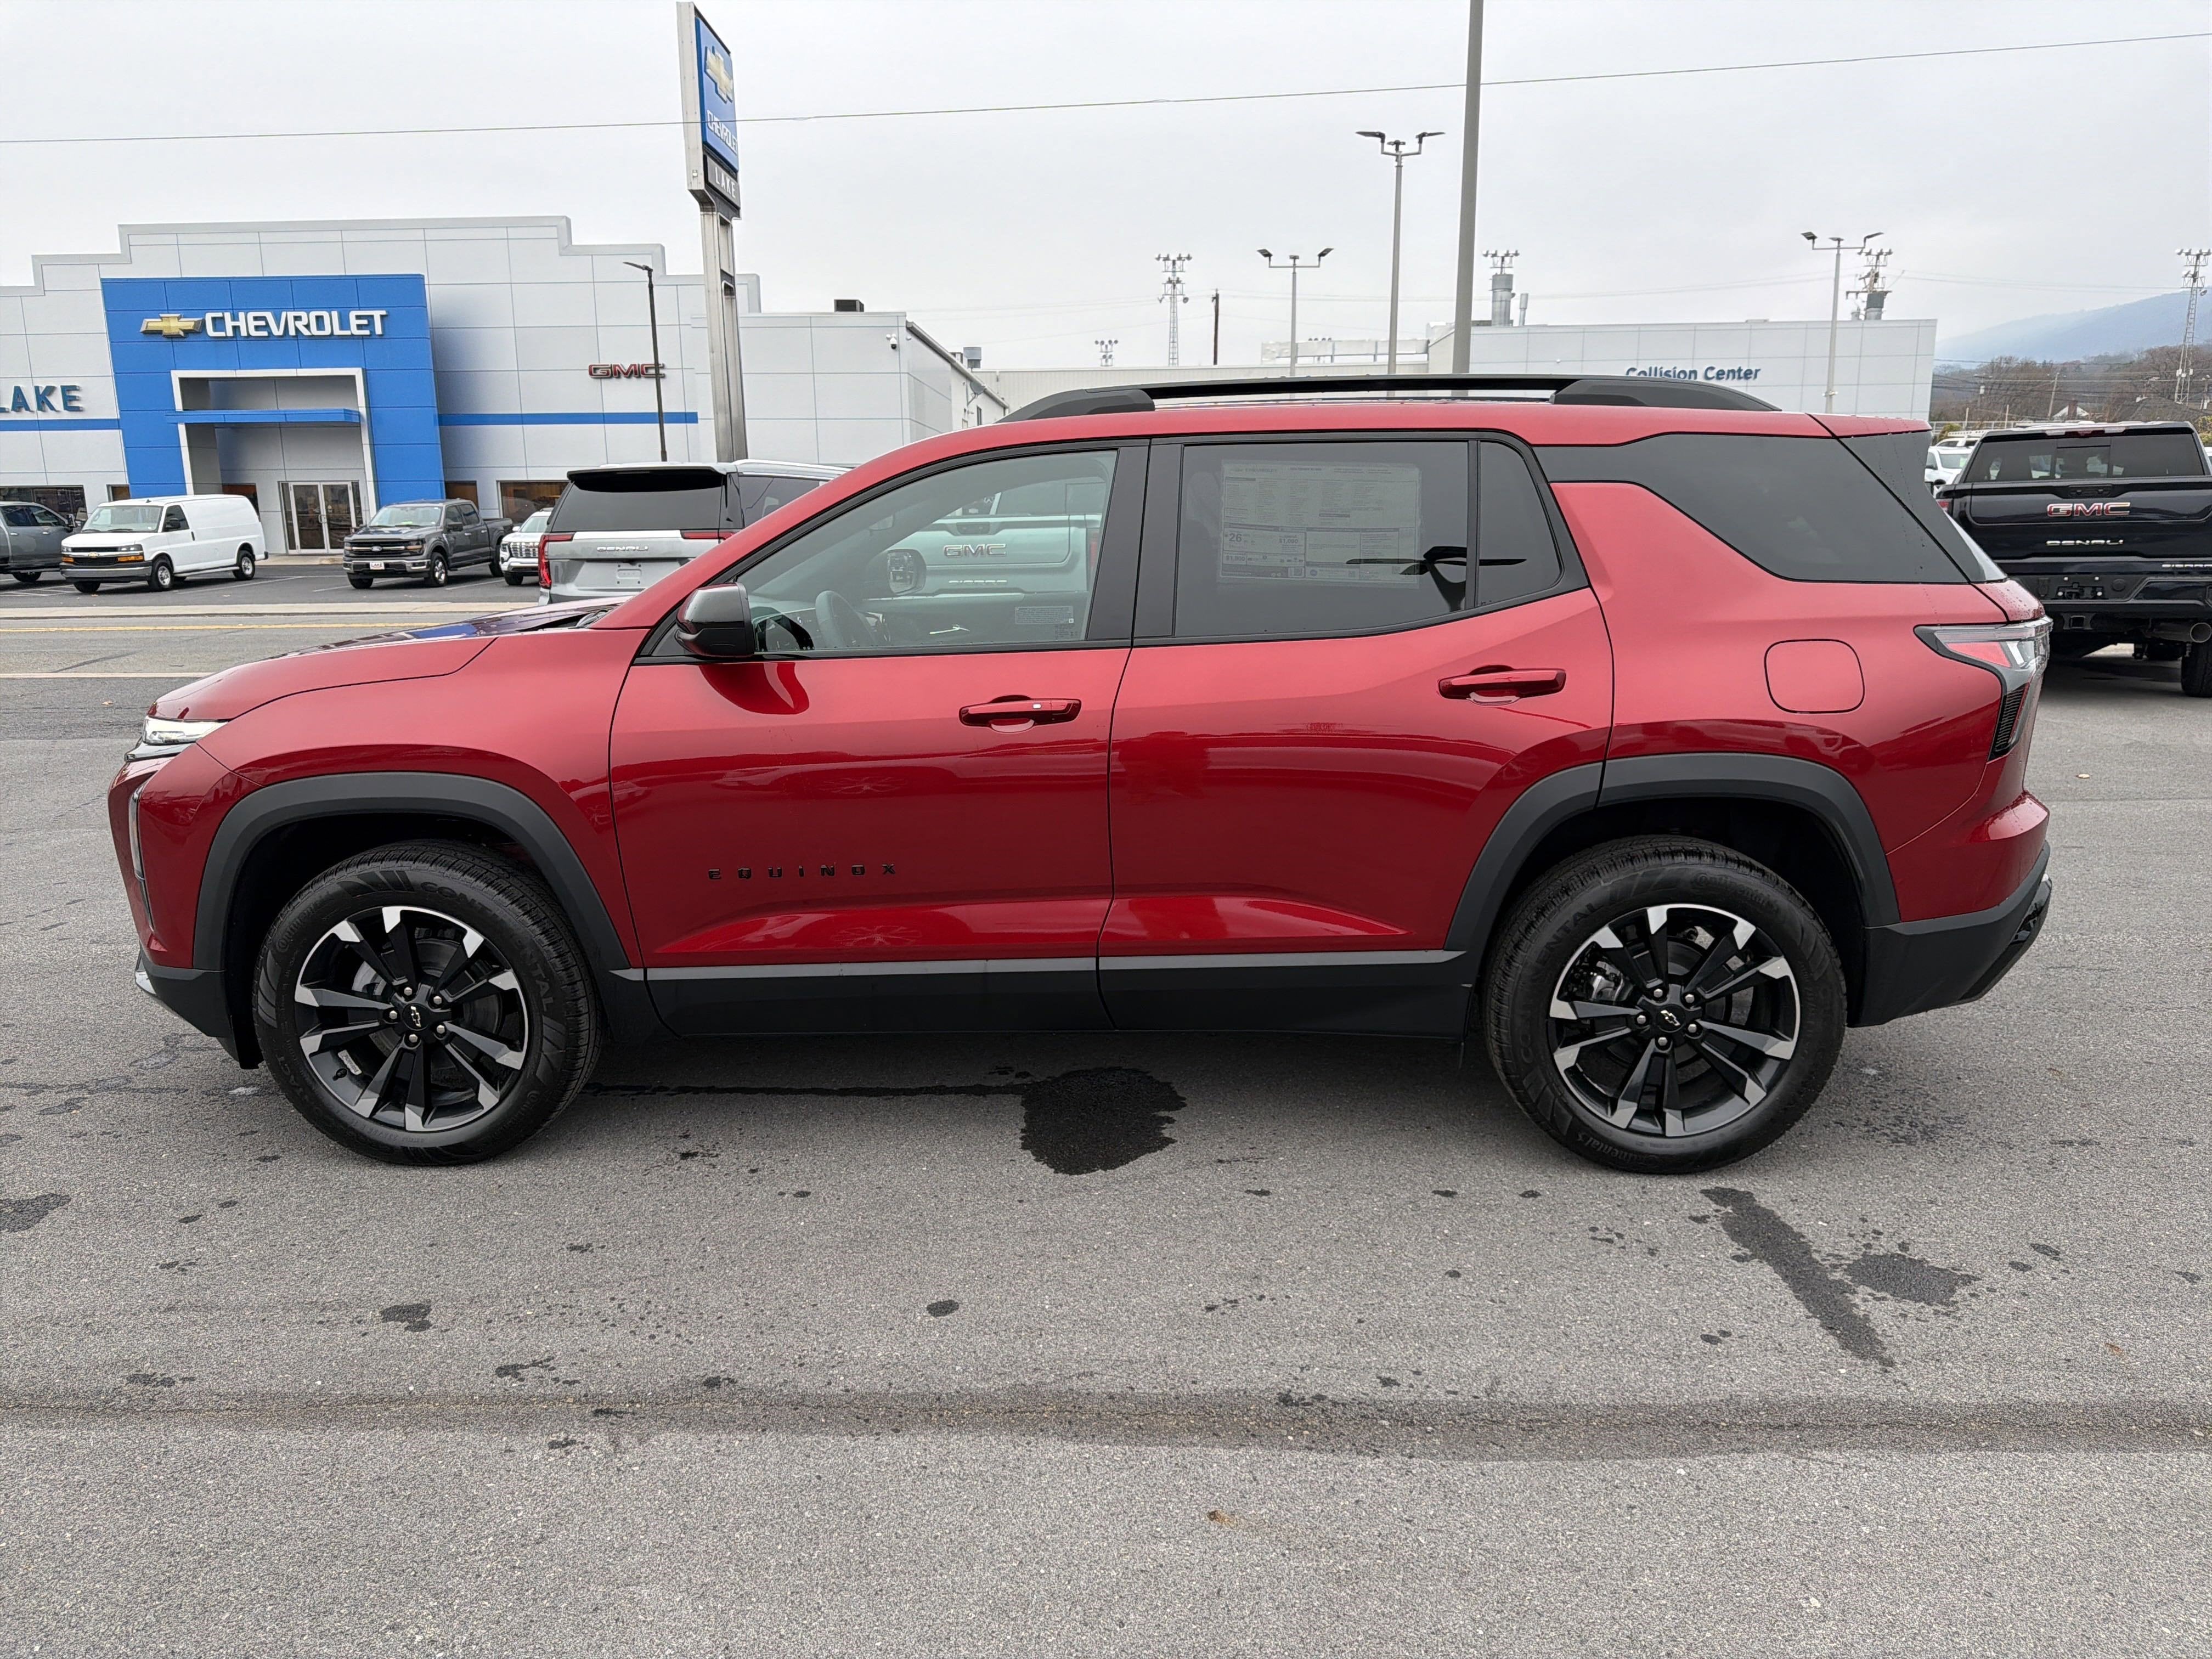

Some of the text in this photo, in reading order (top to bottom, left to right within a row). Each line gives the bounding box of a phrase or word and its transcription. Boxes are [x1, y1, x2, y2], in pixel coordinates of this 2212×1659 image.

[715, 166, 736, 198] LAKE
[205, 310, 388, 337] CHEVROLET
[589, 363, 666, 378] GMC
[1704, 366, 1762, 380] Center
[2047, 502, 2131, 517] GMC
[1228, 533, 1243, 543] 26
[944, 544, 1006, 557] GMC
[708, 864, 896, 879] EQUINOX
